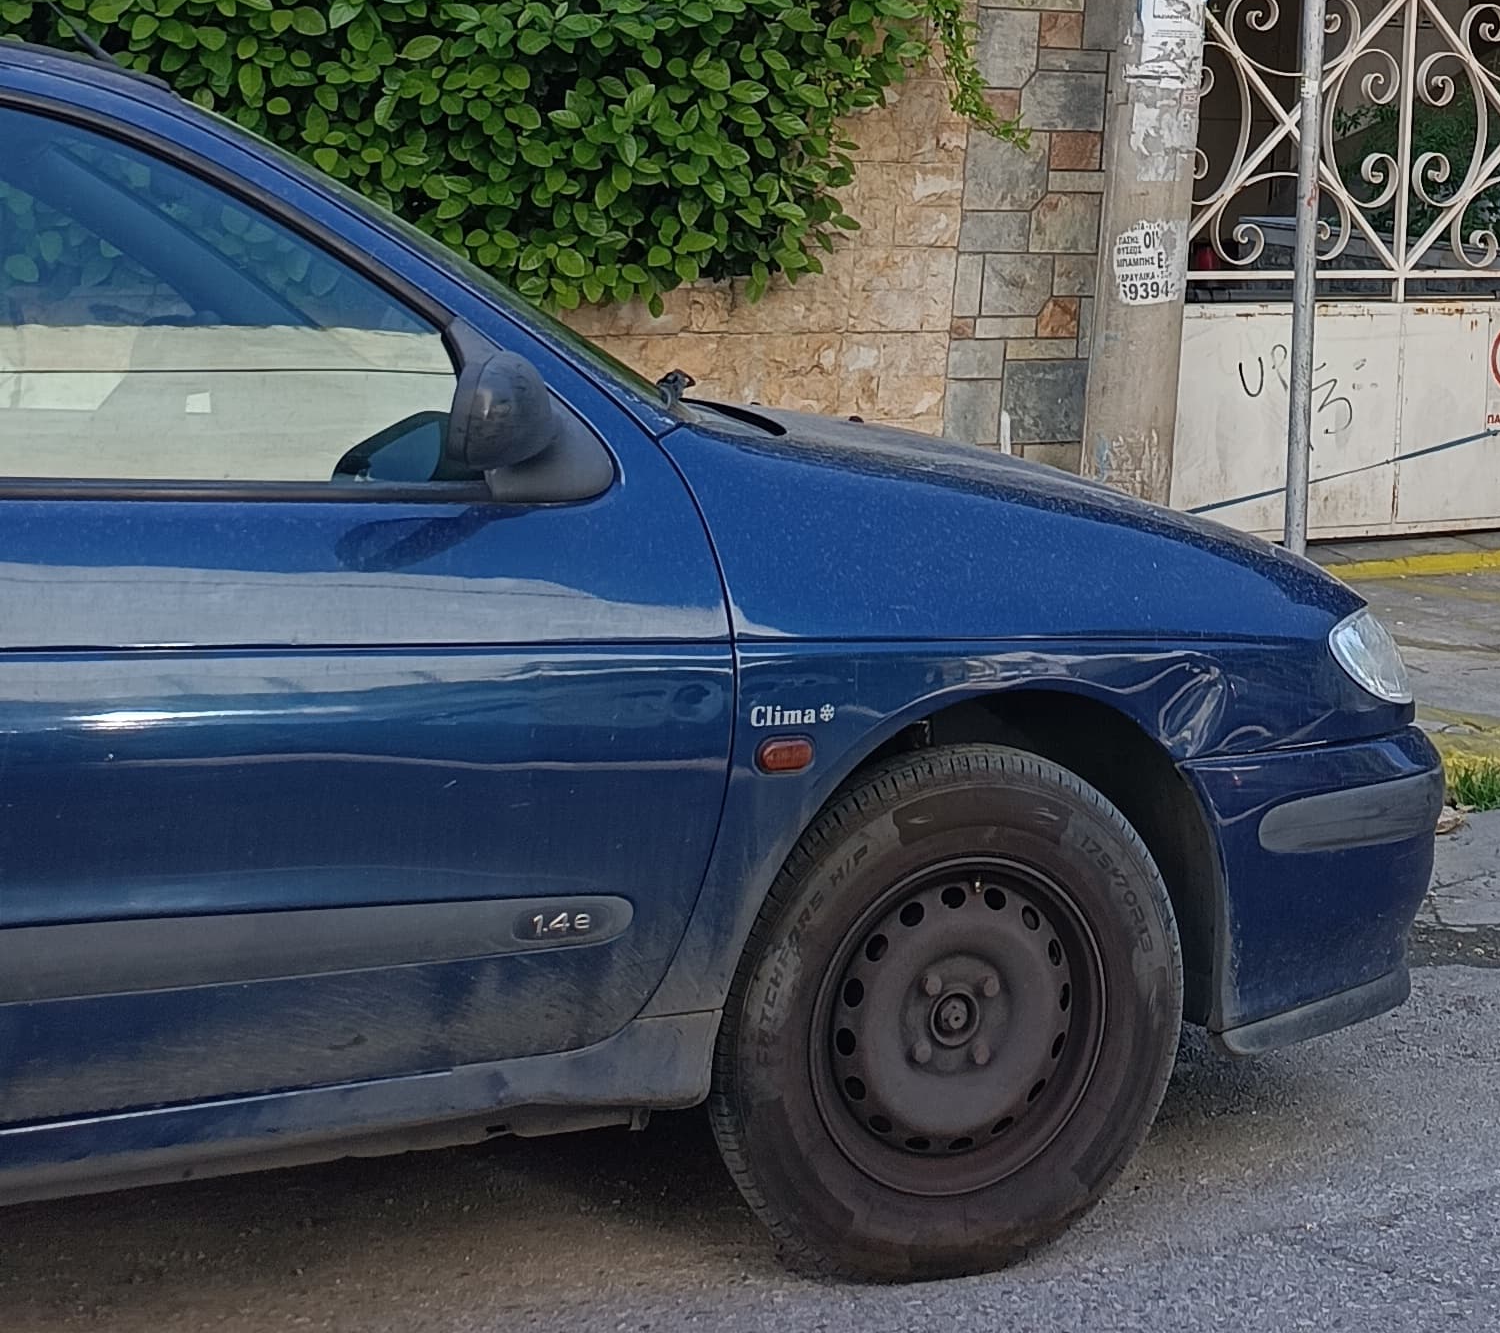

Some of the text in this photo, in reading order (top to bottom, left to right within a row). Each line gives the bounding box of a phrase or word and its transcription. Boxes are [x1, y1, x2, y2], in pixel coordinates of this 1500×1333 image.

[1118, 272, 1156, 282] ΔΡΑΥΛΙΚΑ
[750, 704, 816, 728] Clima
[532, 911, 591, 937] 1.4e
